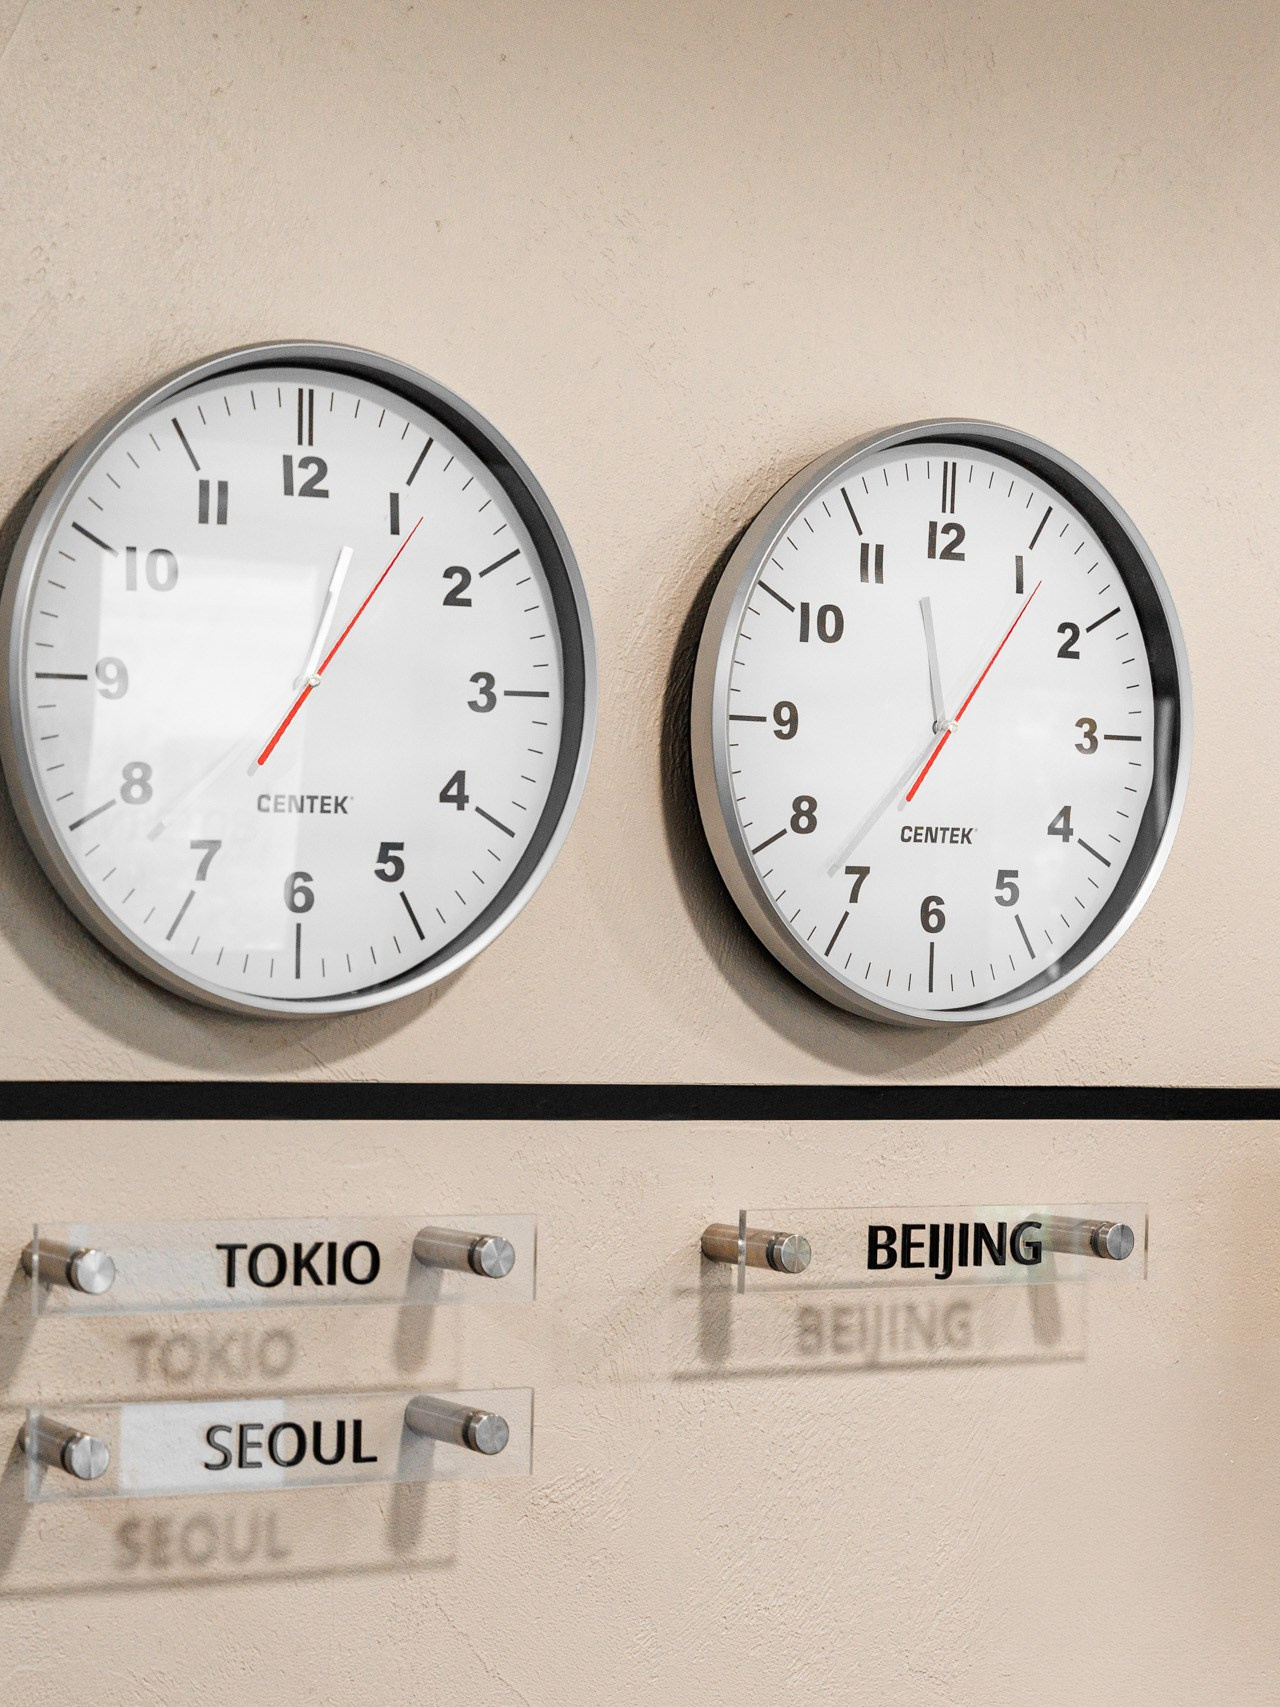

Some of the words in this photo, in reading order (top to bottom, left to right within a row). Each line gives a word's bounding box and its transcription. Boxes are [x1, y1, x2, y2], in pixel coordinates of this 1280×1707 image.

[282, 454, 330, 499] 12
[927, 520, 966, 562] 12
[124, 545, 180, 592] 10
[442, 565, 472, 608] 2
[799, 601, 845, 644] 10
[1056, 621, 1081, 660] 2
[93, 656, 129, 700] 9
[467, 671, 497, 713] 3
[772, 700, 799, 741] 9
[1074, 717, 1099, 755] 3
[119, 761, 153, 805] 8
[439, 769, 470, 811] 4
[257, 794, 348, 815] CENTEK
[789, 794, 818, 835] 8
[1047, 805, 1074, 843] 4
[900, 825, 974, 845] CENTEK
[190, 839, 222, 882] 7
[374, 841, 405, 883] 5
[283, 871, 316, 914] 6
[844, 865, 871, 904] 7
[994, 869, 1020, 907] 5
[920, 895, 946, 934] 6
[216, 1239, 381, 1289] TOKIO
[867, 1220, 1043, 1280] BEIJING
[203, 1419, 378, 1471] SEOUL
